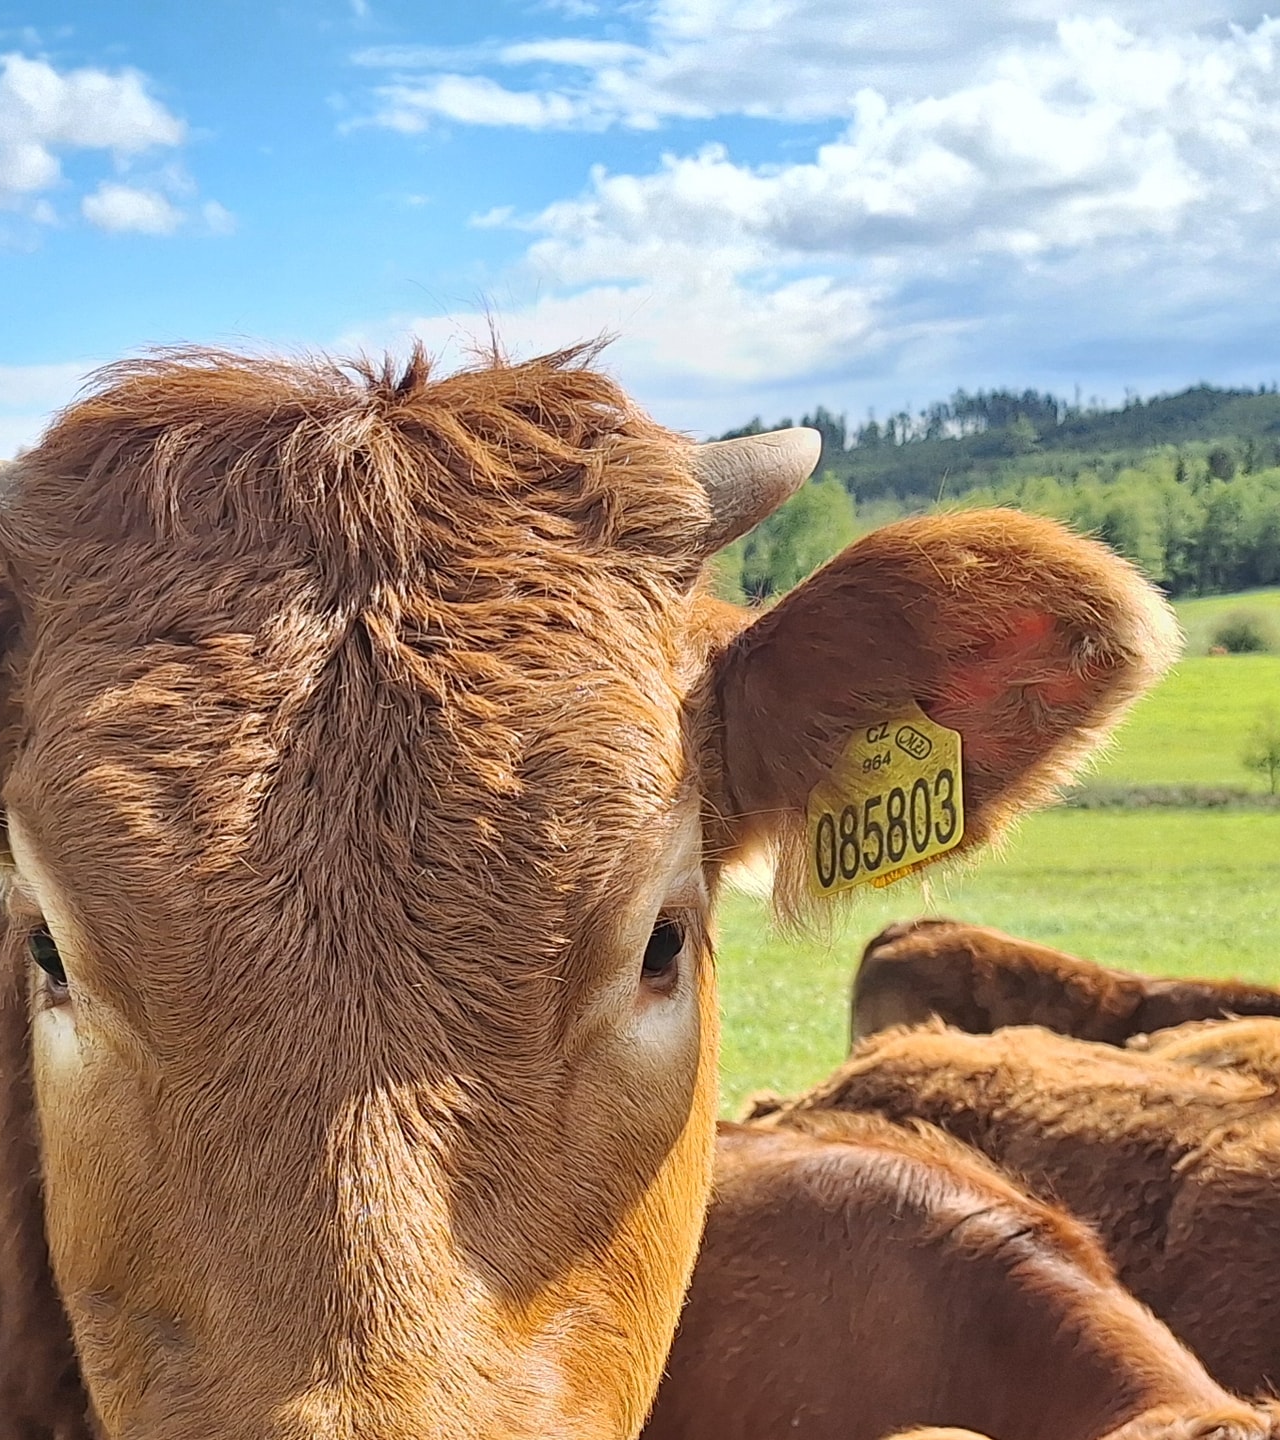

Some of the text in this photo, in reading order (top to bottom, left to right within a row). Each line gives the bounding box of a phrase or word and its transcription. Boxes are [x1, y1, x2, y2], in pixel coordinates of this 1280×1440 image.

[866, 721, 890, 744] CZ
[862, 750, 892, 774] 964
[816, 768, 957, 888] 085803
